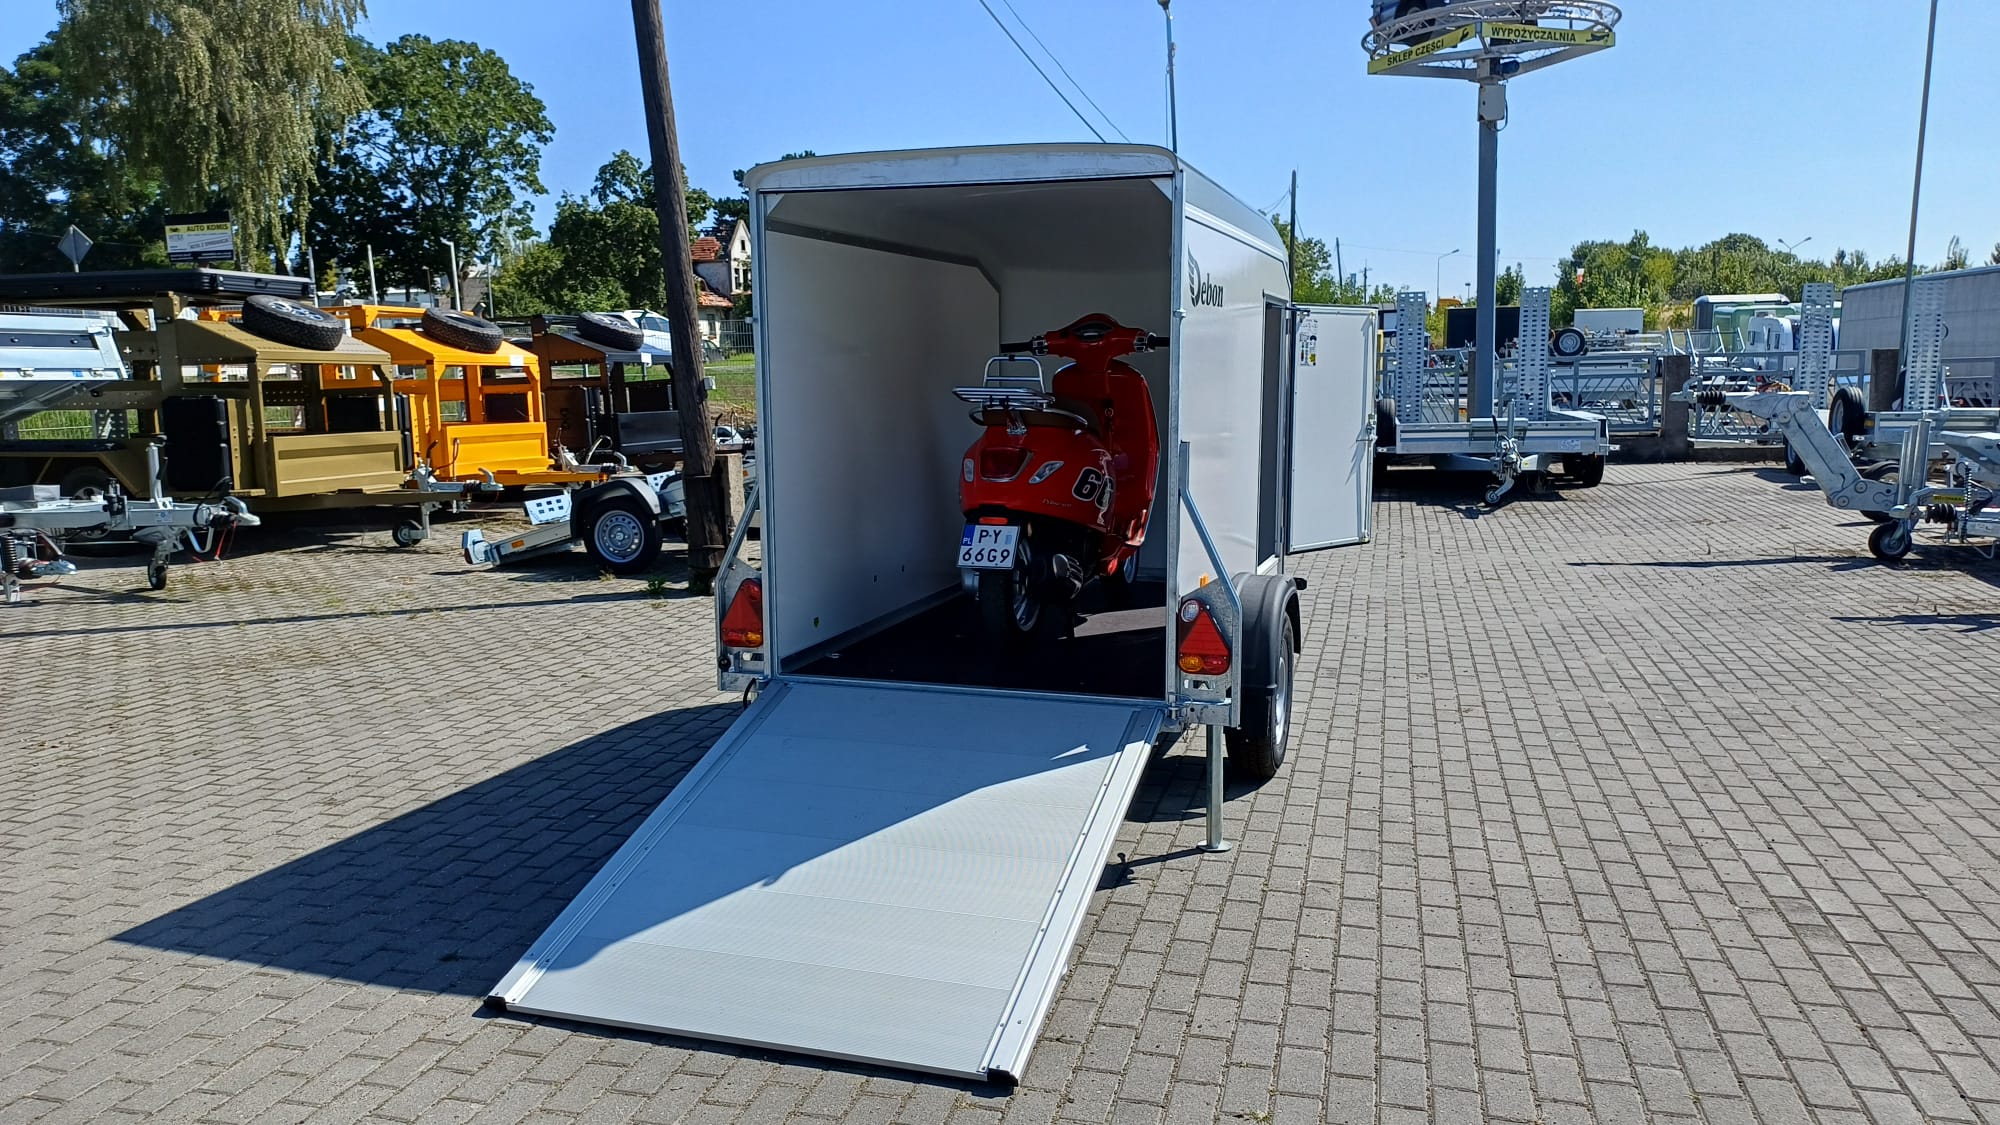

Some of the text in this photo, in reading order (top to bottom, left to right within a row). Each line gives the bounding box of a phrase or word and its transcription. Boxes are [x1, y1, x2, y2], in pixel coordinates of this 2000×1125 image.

[1491, 26, 1577, 42] WYPOŻYCZALNIA
[1387, 50, 1413, 66] SKLEP
[206, 223, 229, 231] KOMIS
[962, 537, 971, 545] PL
[962, 547, 1010, 564] 66G9
